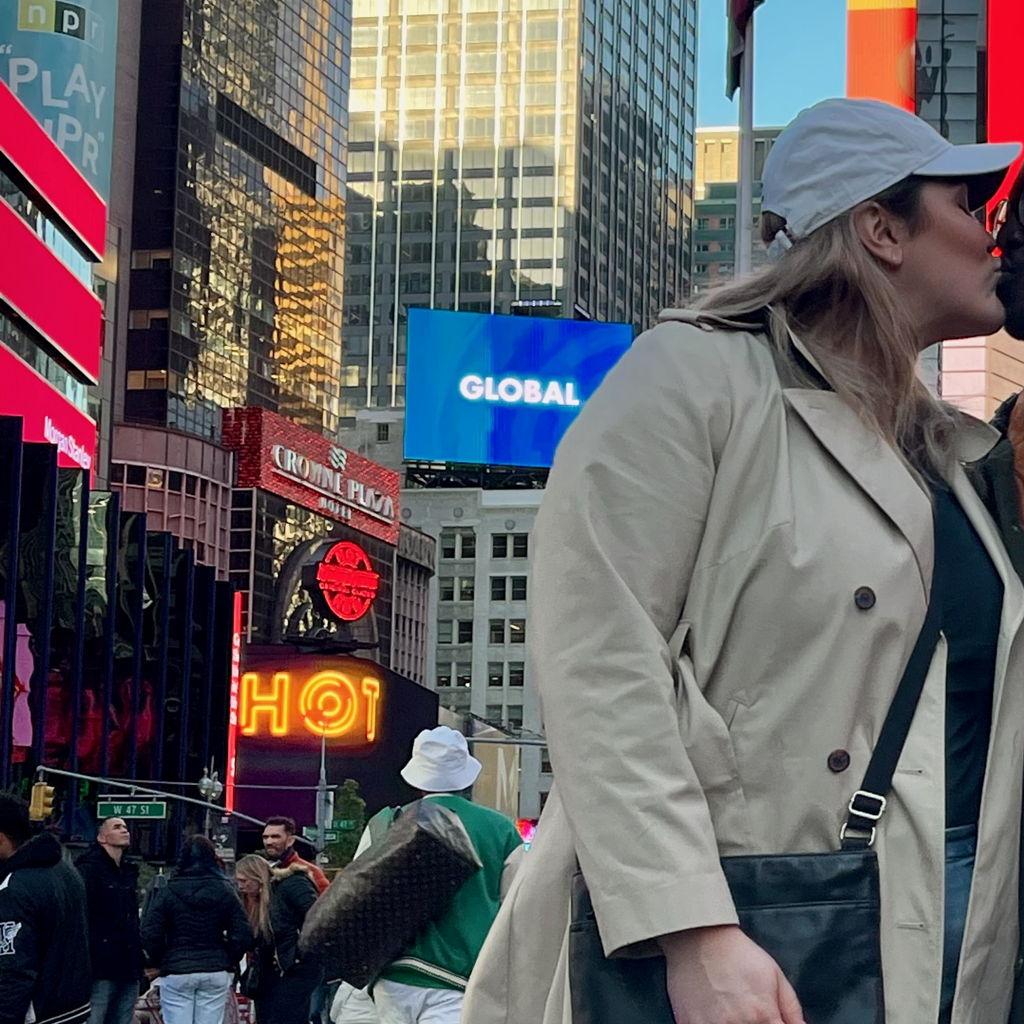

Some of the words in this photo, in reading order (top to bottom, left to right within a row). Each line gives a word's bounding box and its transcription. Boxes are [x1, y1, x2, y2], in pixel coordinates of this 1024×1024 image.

[28, 5, 99, 39] npr
[459, 375, 580, 406] GLOBAL
[271, 445, 343, 496] CROWNE
[347, 479, 395, 519] PLAZA
[240, 671, 380, 742] HOT
[113, 805, 123, 814] W
[126, 805, 138, 815] 47
[139, 805, 149, 815] ST
